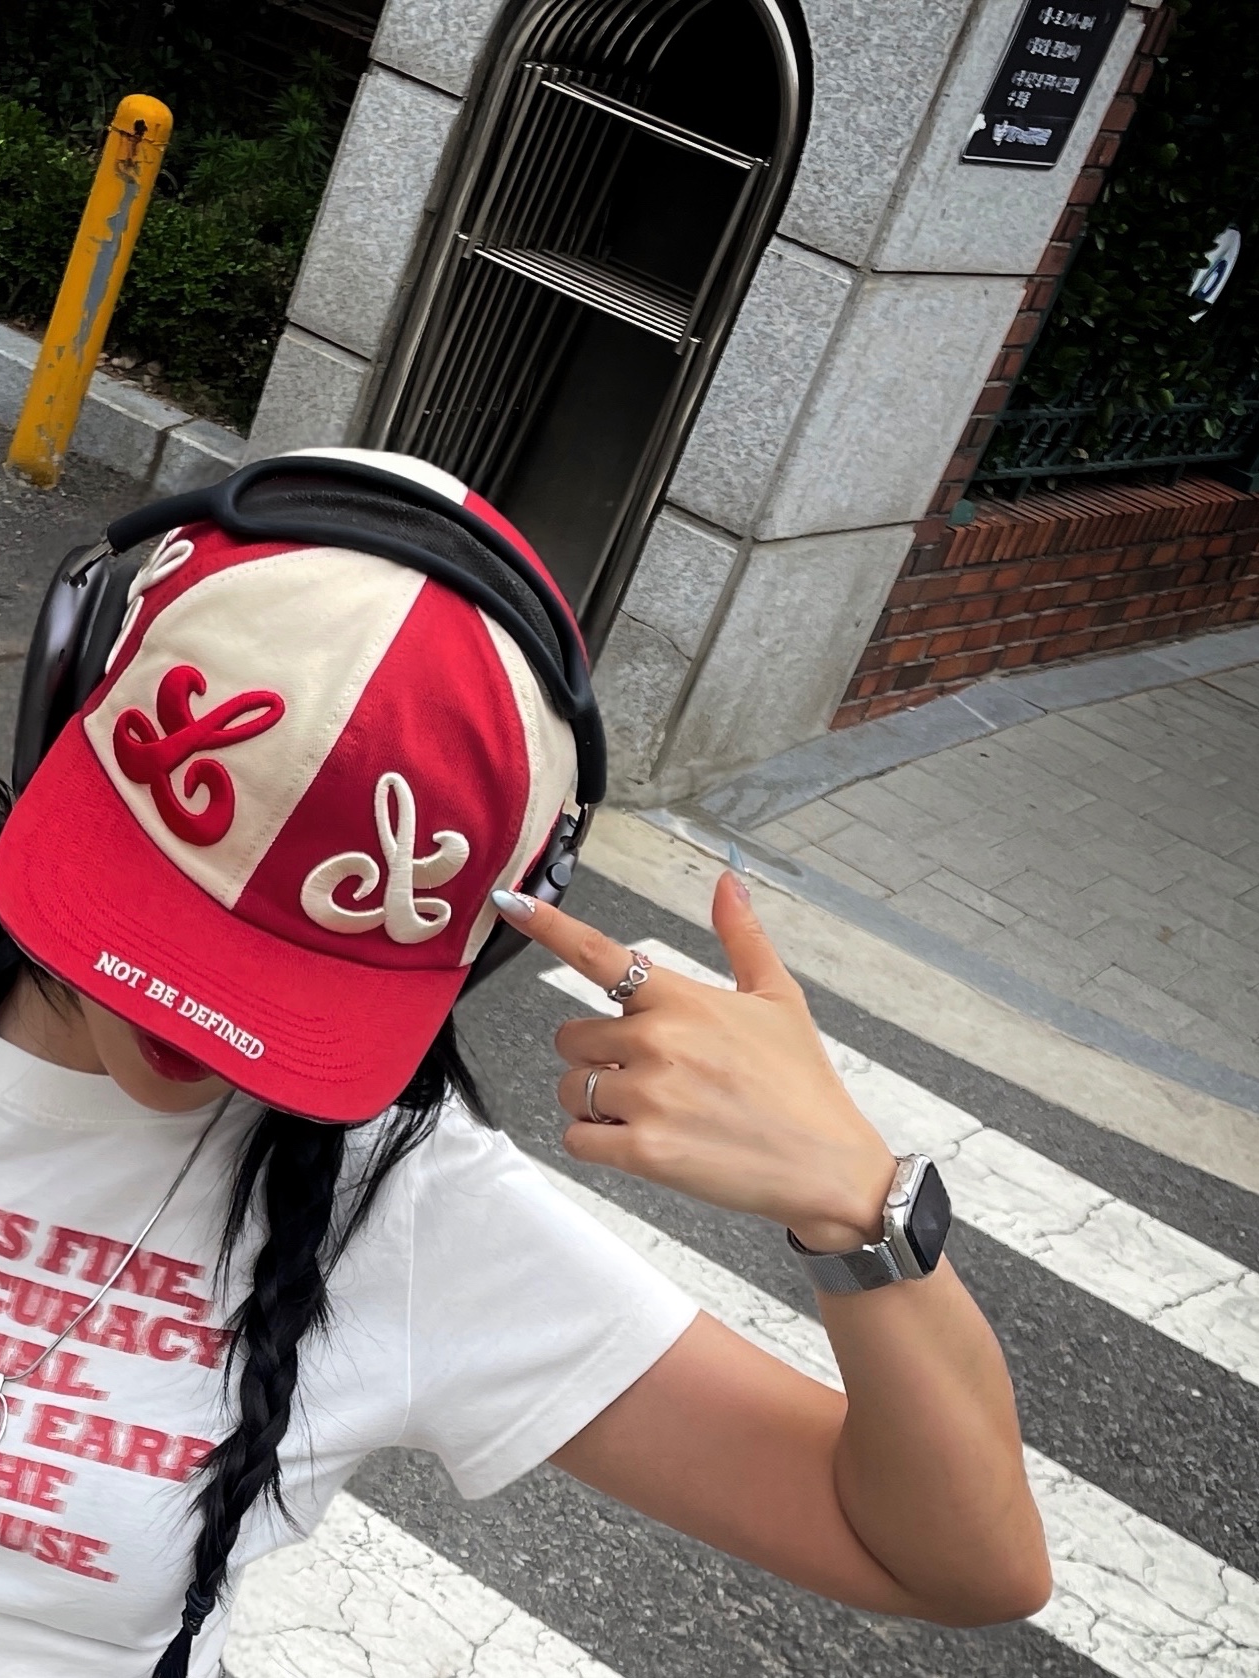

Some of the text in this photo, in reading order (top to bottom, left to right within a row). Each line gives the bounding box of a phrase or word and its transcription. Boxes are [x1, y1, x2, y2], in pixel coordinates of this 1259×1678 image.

[93, 951, 265, 1060] NOT BE DEFINED
